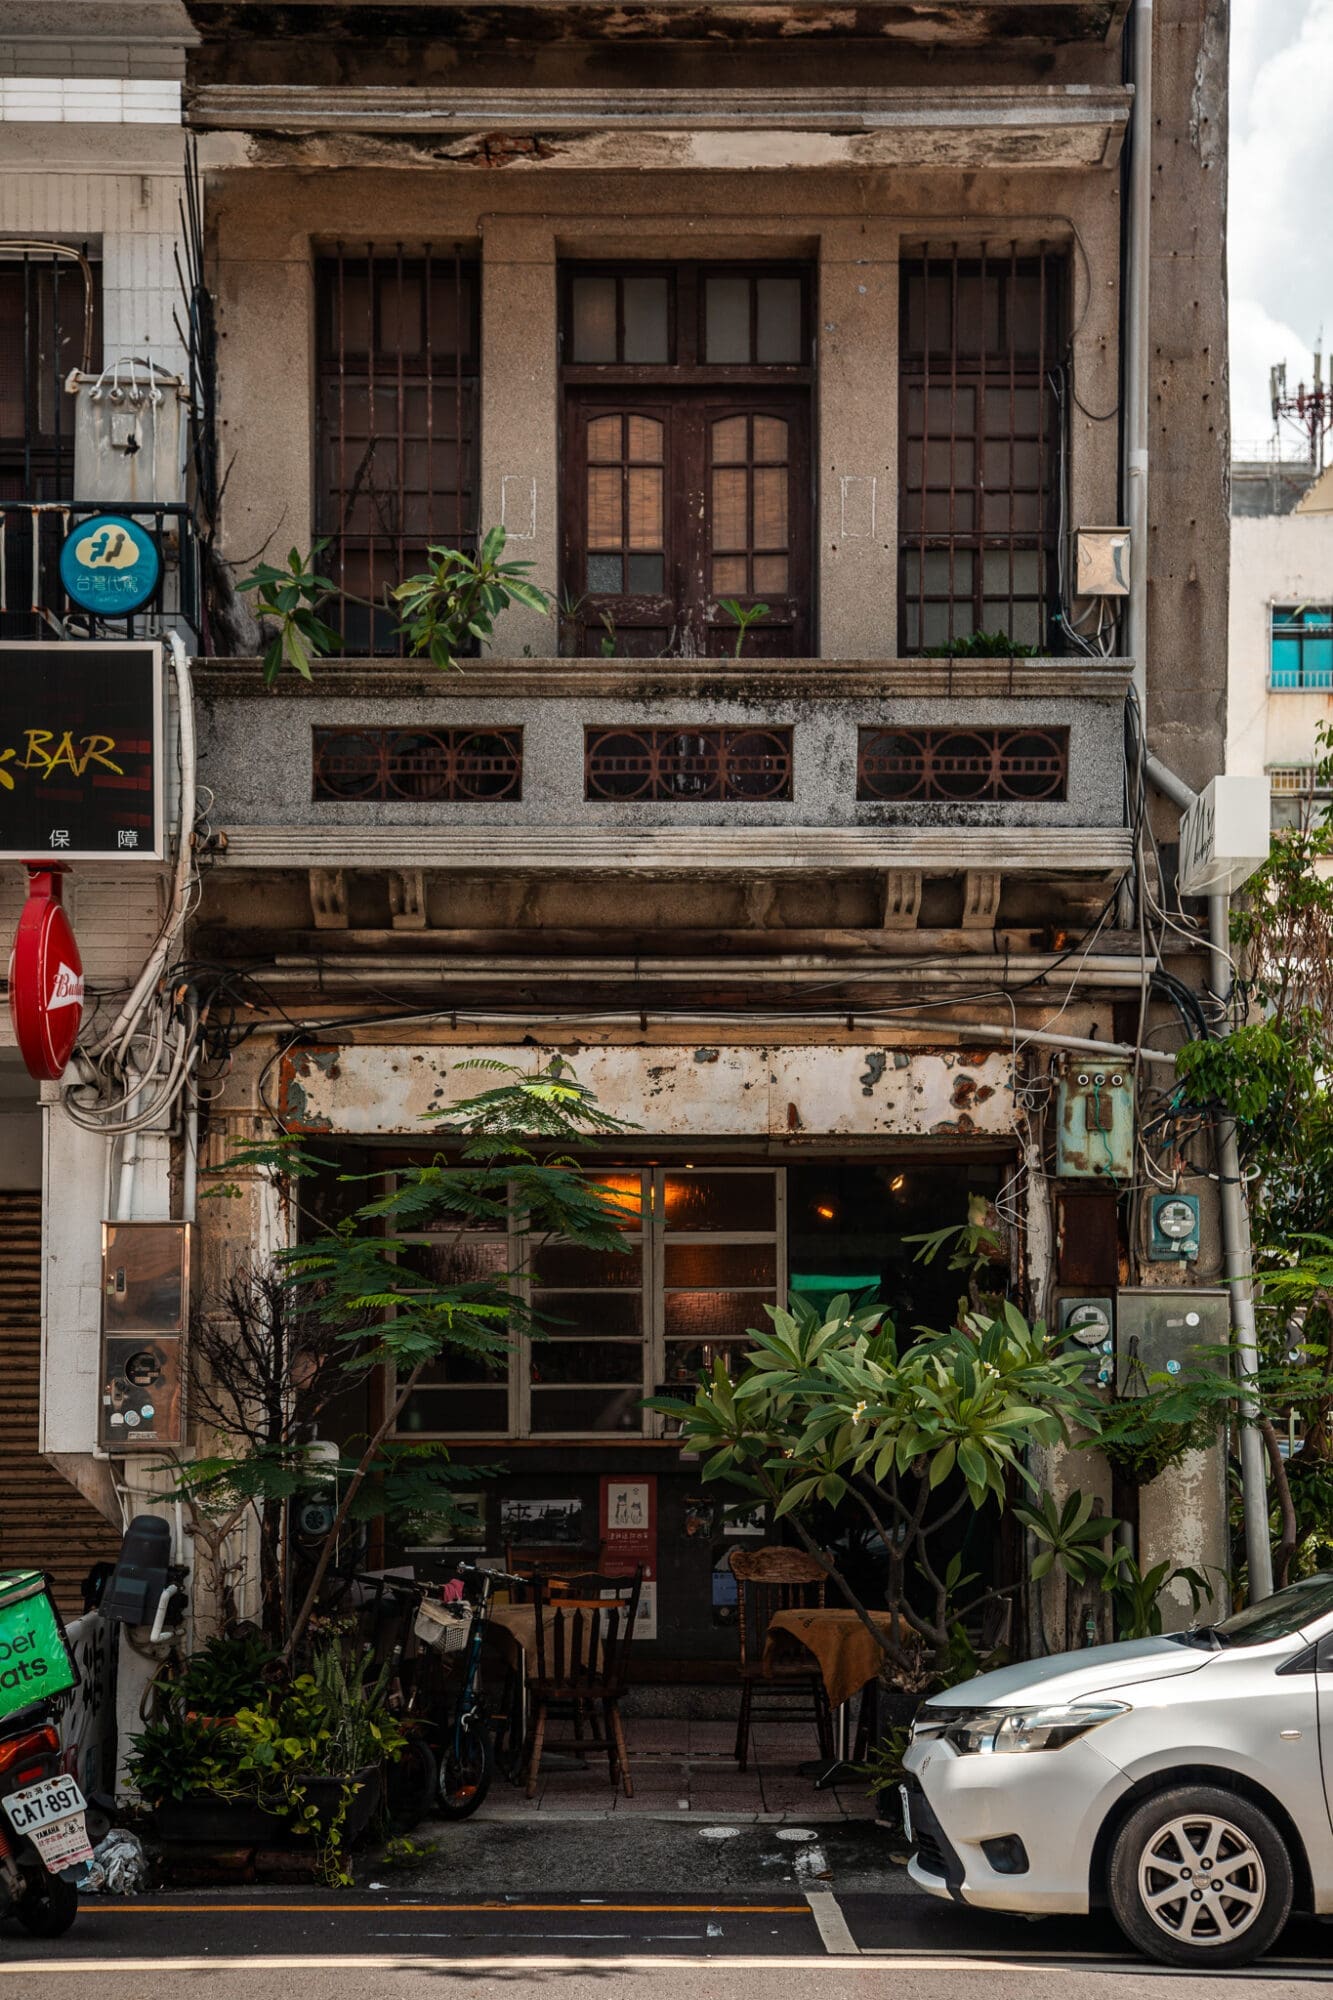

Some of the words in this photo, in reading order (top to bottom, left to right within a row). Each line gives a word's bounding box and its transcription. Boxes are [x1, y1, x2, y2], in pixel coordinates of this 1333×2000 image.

[15, 729, 124, 780] BAR
[0, 1657, 48, 1692] ats
[35, 1825, 60, 1840] YAMAHA
